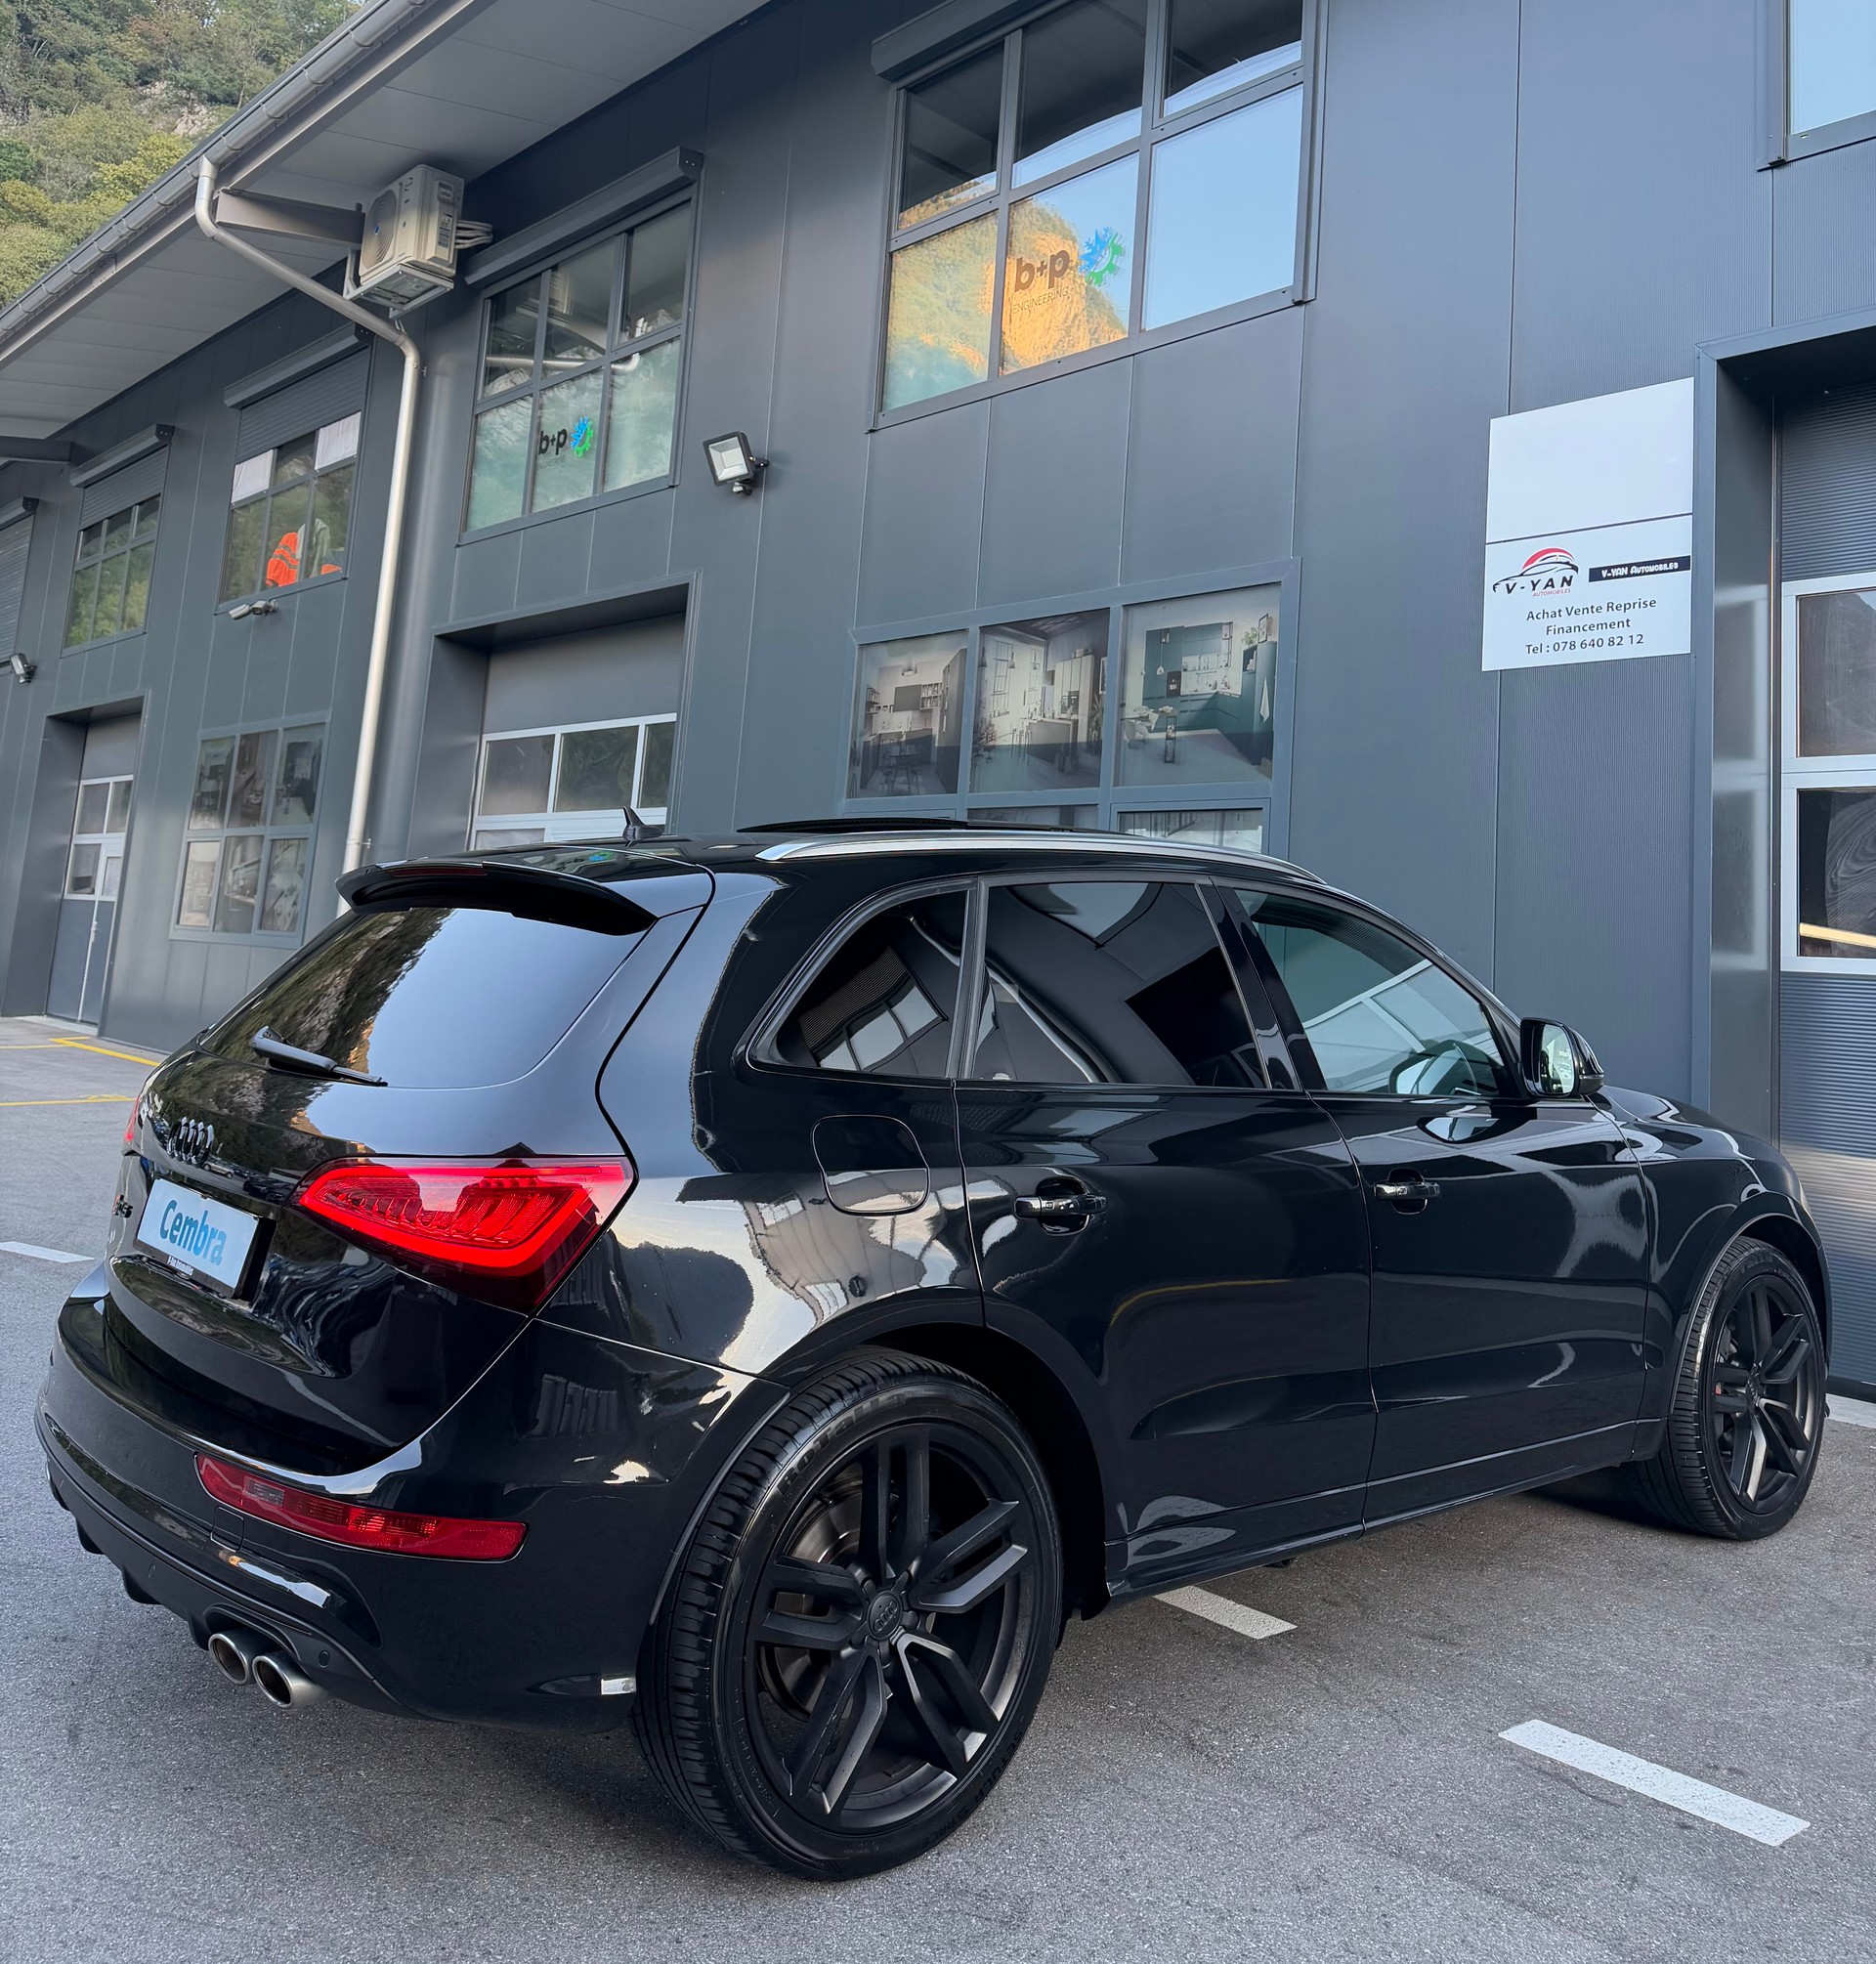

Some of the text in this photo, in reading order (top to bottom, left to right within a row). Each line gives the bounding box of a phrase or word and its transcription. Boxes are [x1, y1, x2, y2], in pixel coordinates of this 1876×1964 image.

[1012, 287, 1069, 314] ENGINEERING
[1601, 567, 1628, 577] V-YAN
[1532, 588, 1571, 597] AUTOMOBILES
[1526, 598, 1657, 620] Achat Vente Reprise
[1546, 619, 1631, 635] Financement
[1553, 641, 1576, 652] 078
[1580, 638, 1603, 649] 640
[1607, 635, 1623, 646] 82
[1628, 633, 1643, 644] 12
[159, 1200, 227, 1265] Cembra
